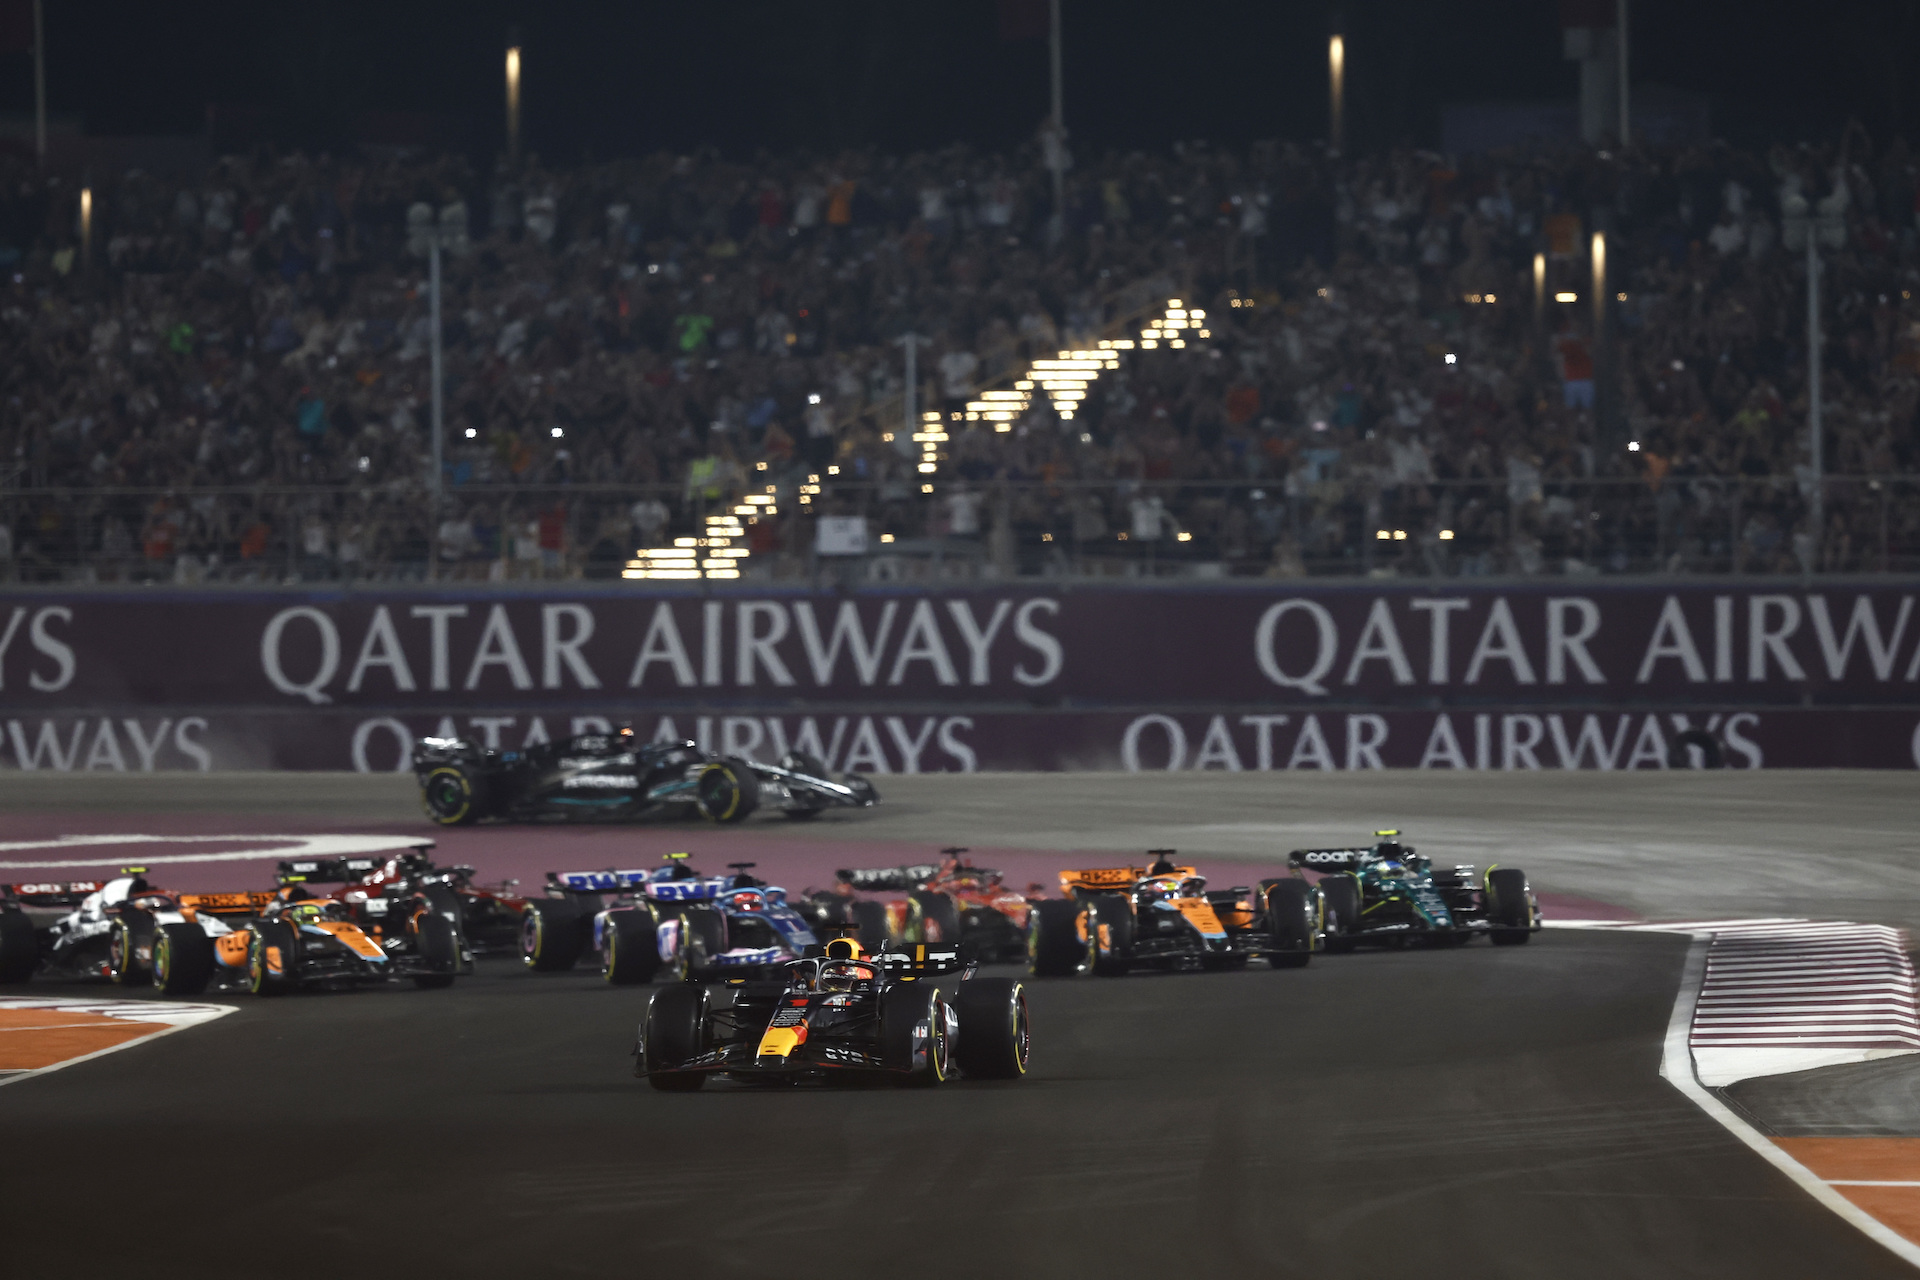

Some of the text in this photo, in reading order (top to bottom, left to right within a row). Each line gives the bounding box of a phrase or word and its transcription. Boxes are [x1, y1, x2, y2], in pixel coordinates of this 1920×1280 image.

[261, 599, 1065, 703] QATAR AIRWAYS
[1254, 594, 1920, 697] QATAR AIRW
[1121, 713, 1386, 772] QATAR
